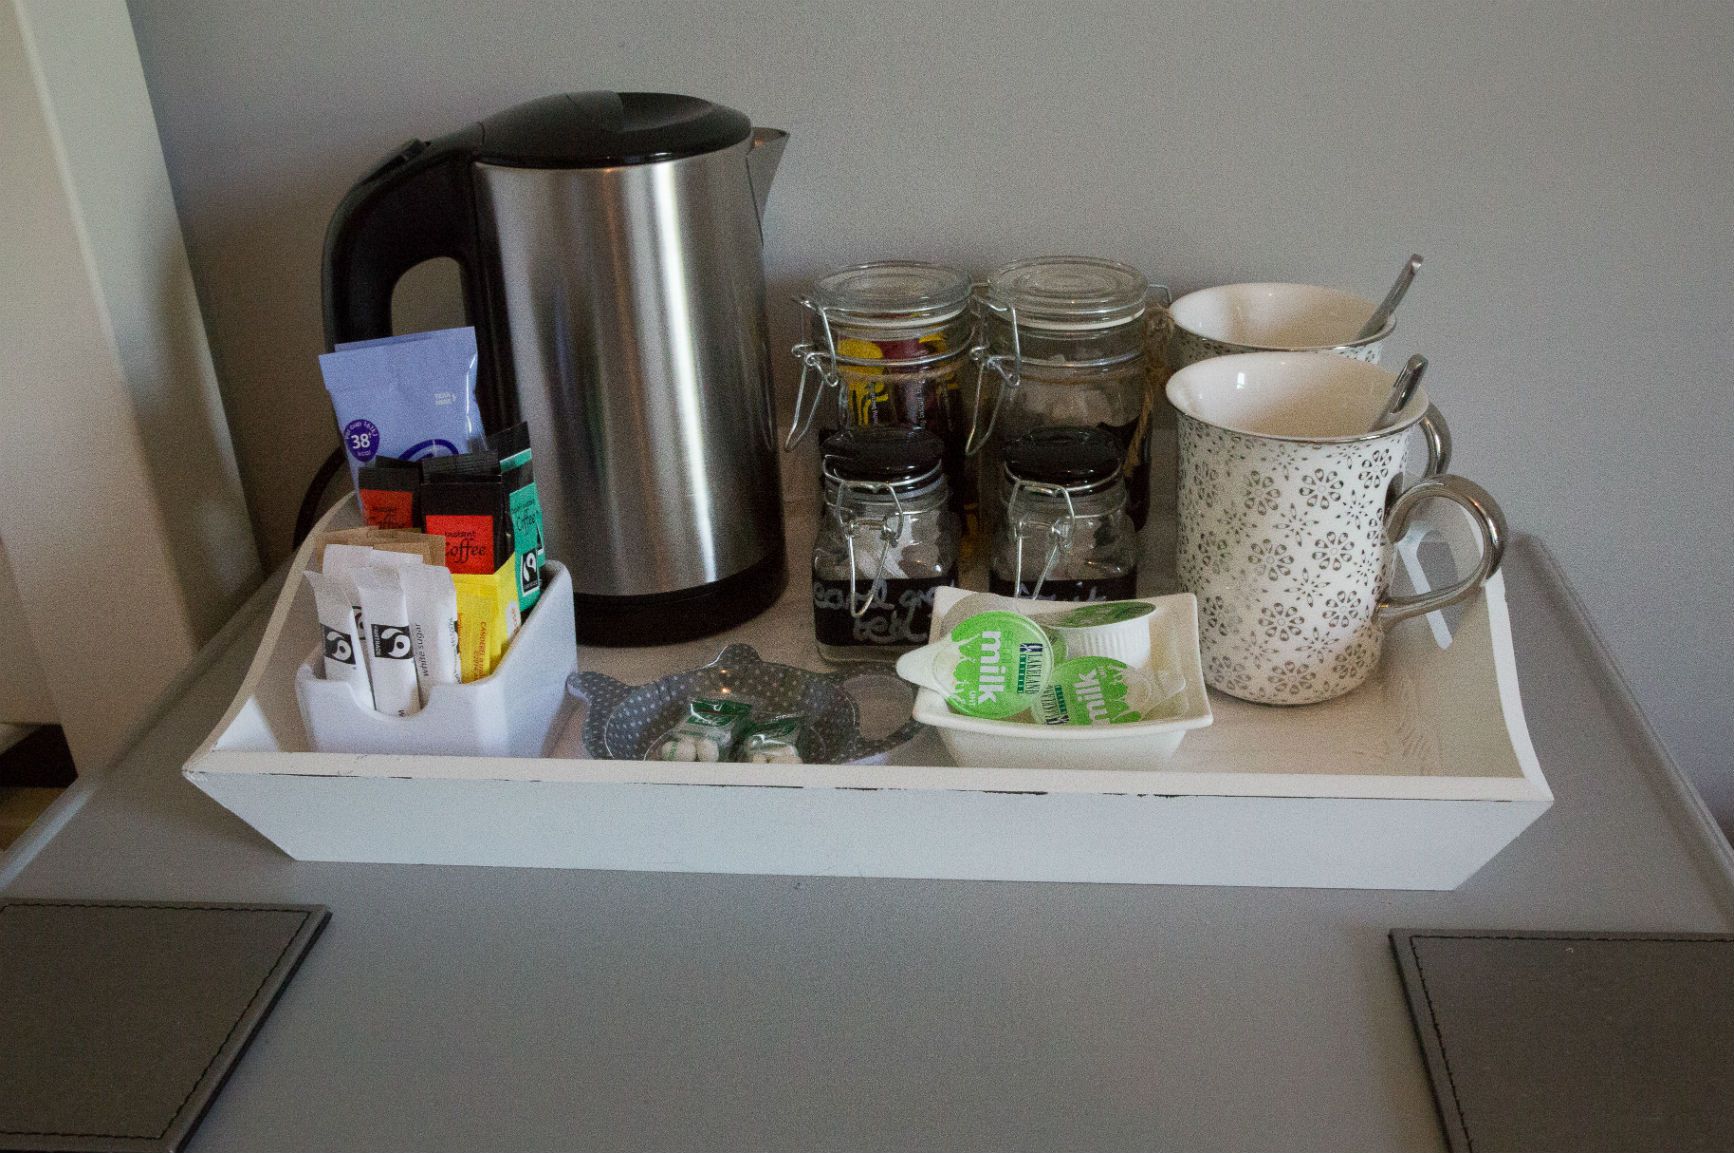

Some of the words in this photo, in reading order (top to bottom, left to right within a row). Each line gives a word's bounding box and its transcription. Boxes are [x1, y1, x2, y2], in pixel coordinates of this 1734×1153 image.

[415, 624, 424, 652] sugar
[419, 652, 429, 677] white
[978, 631, 1007, 704] milk
[1073, 669, 1108, 721] milk
